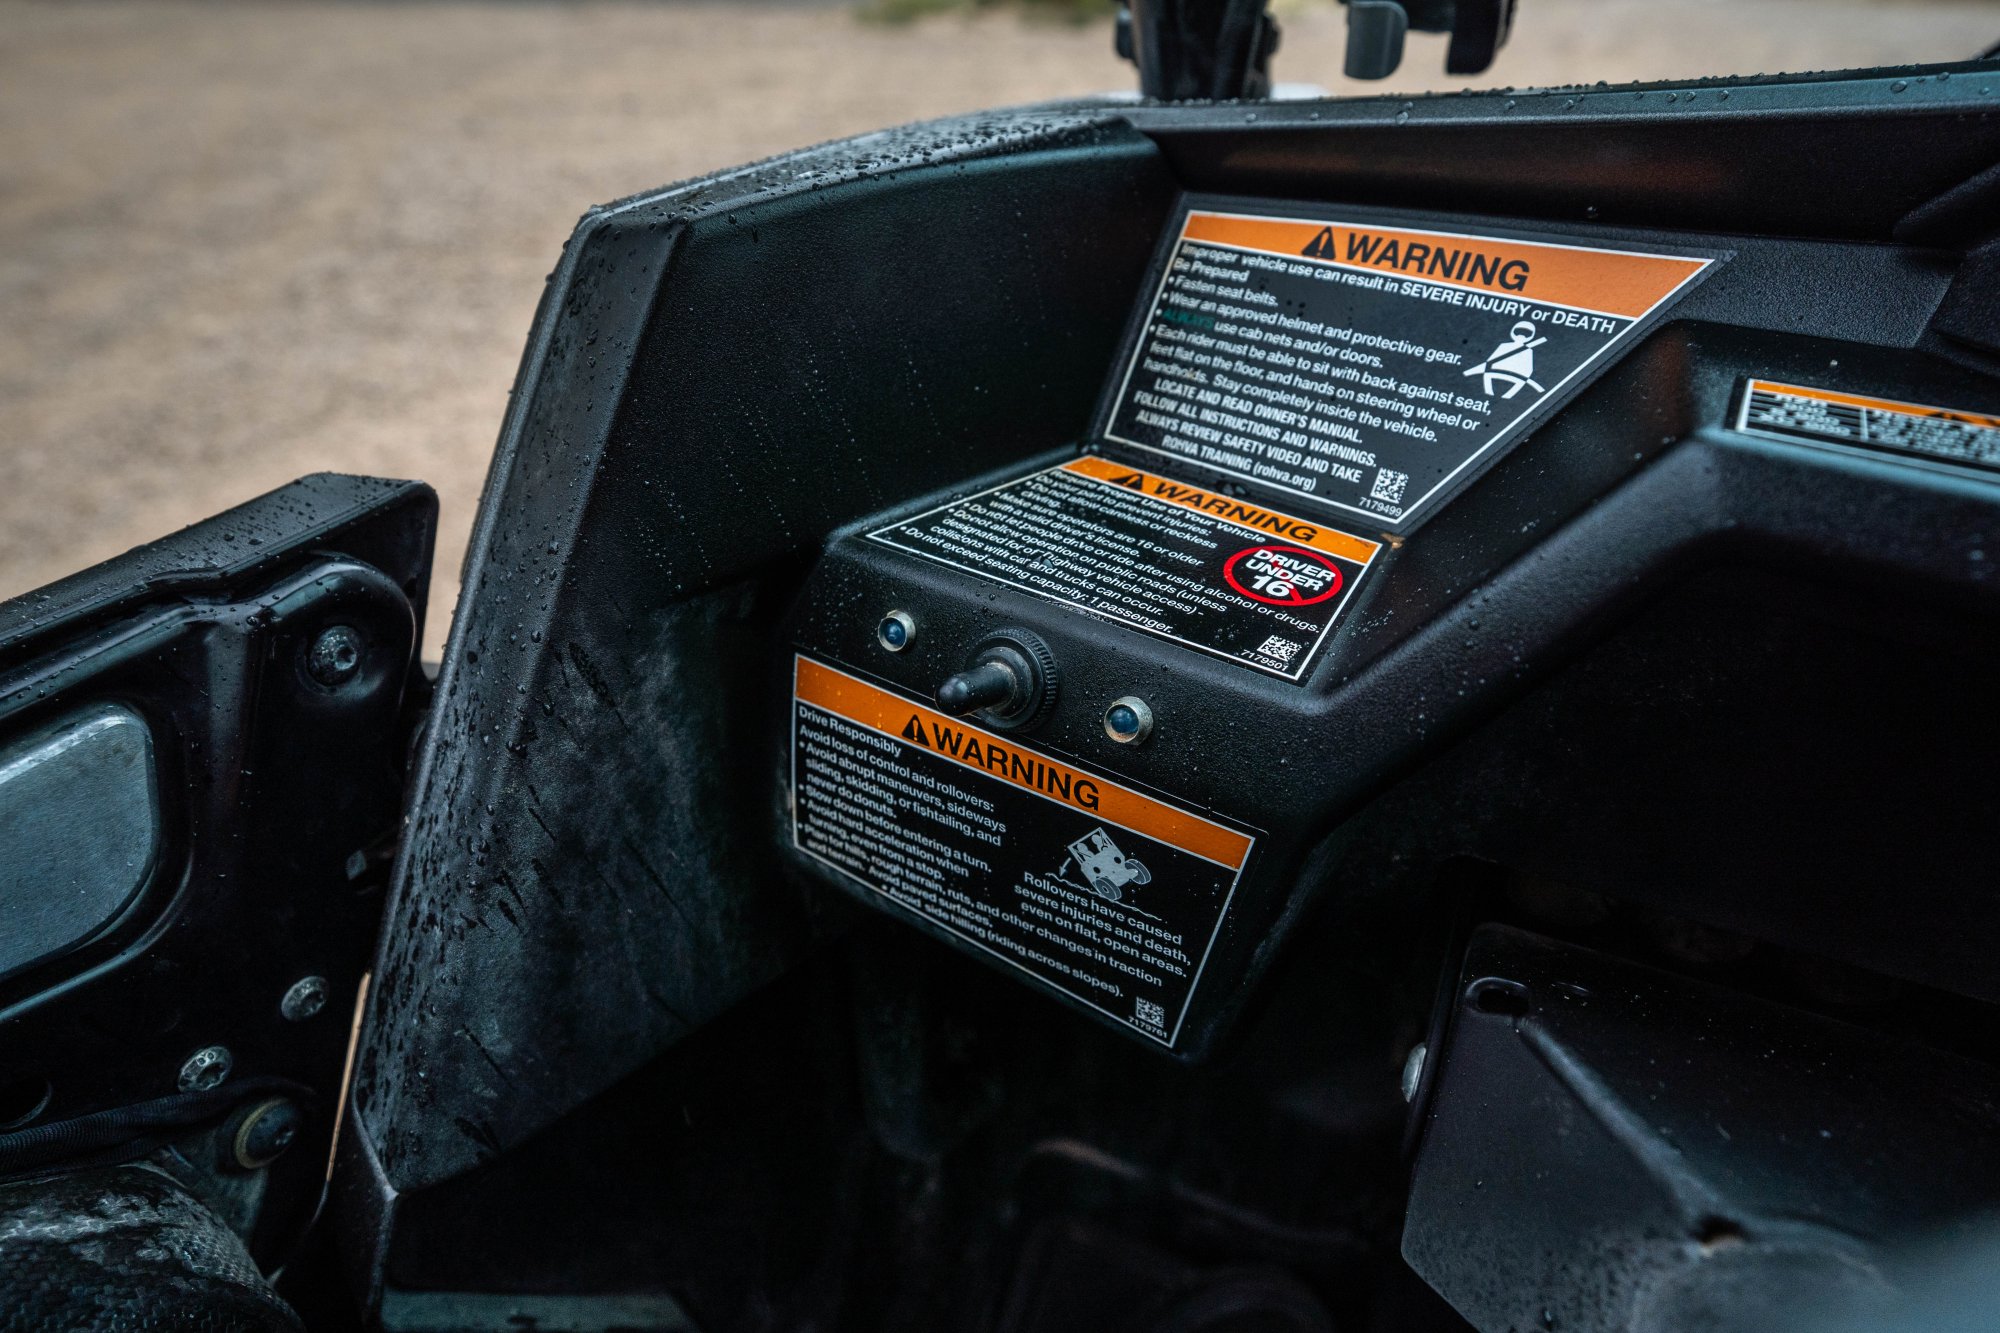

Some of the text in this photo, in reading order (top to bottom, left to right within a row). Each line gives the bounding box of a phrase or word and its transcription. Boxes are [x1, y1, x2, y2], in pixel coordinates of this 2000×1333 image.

[1172, 257, 1250, 282] Be Prepared
[1174, 274, 1278, 306] Fasten seat belts.
[1346, 232, 1530, 292] WARNING
[1241, 255, 1616, 334] vehicle use can result in SEVERE INJURY or DEATH
[1169, 291, 1462, 365] Wear an approved helmet and protective gear.
[1213, 321, 1383, 368] use cab nets and/or doors.
[1155, 323, 1491, 416] Each rider must be able to sit with back against seat,
[1193, 353, 1481, 431] on the floor, and hands on steering wheel or
[1154, 378, 1362, 443] LOCATE AND READ OWNER'S MANUAL.
[1176, 402, 1376, 467] ALL INSTRUCTIONS AND WARNINGS.
[1212, 373, 1437, 442] Stay completely inside the vehicle.
[1179, 421, 1363, 483] REVIEW SAFETY VIDEO AND TAKE
[1200, 445, 1317, 491] TRAINING (rohva.org)
[1153, 482, 1318, 542] WARNING
[1184, 511, 1266, 543] Your Vehicle
[1358, 496, 1402, 517] 7179499
[942, 518, 1197, 615] designated for vehicle access)
[1093, 535, 1140, 557] license.
[1136, 539, 1204, 566] 16 or older
[1163, 527, 1218, 549] reckless
[1254, 549, 1335, 581] DRIVER
[904, 526, 1173, 636] Do not exceed seating capacity: 1 passenger.
[983, 544, 1163, 615] with trucks can occur.
[1018, 522, 1319, 633] people or ride after using alcohol or drugs.
[1021, 534, 1227, 612] operation on public roads (unless
[1245, 558, 1323, 591] UNDER
[1252, 575, 1294, 597] 16
[1240, 649, 1288, 671] 7179501
[798, 705, 901, 757] Drive Responsibly
[799, 724, 994, 812] Avoid loss of control and rollovers:
[805, 742, 1006, 832] Avoid abrupt maneuvers, sideways
[932, 722, 1100, 811] WARNING
[853, 793, 897, 818] donuts.
[897, 797, 1001, 846] or fishtailing, and
[902, 828, 992, 873] entering a turn.
[935, 856, 969, 877] when
[1014, 884, 1191, 966] severe injuries and death,
[1024, 871, 1182, 945] Rollovers have caused
[975, 901, 1162, 986] and other changes in traction
[1020, 902, 1187, 978] even on flat, open areas.
[1027, 949, 1123, 997] across slopes).
